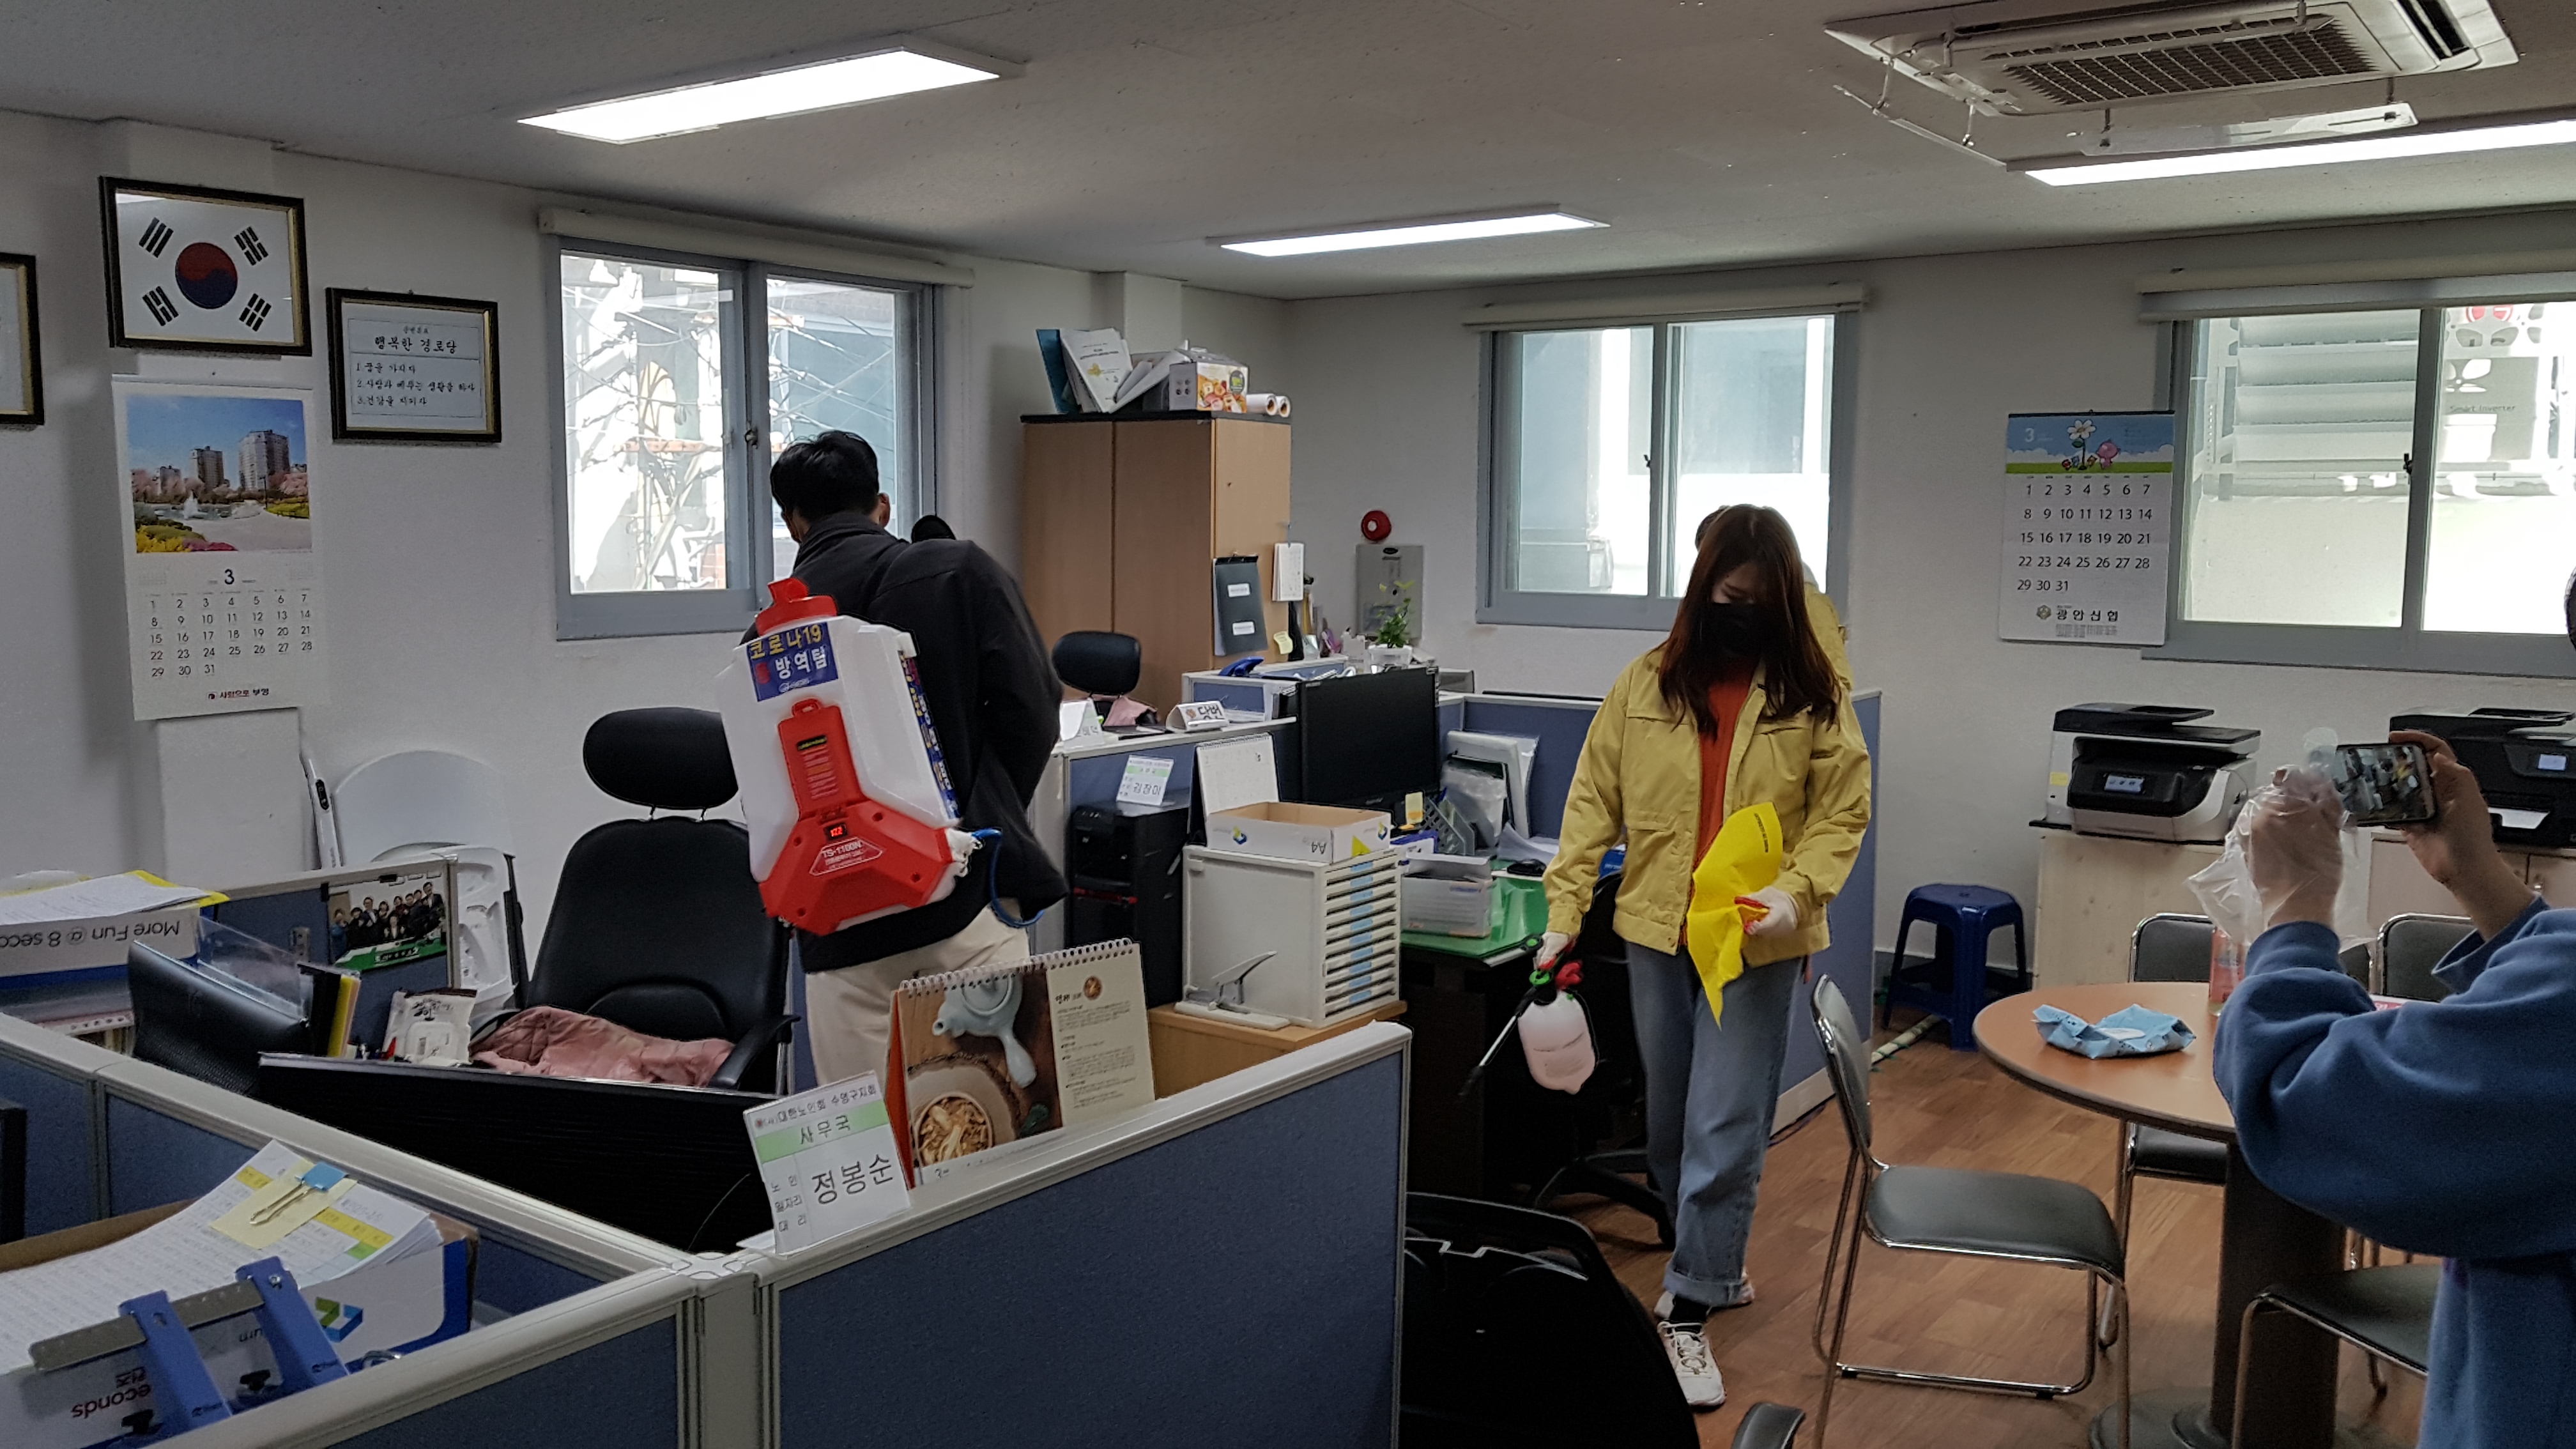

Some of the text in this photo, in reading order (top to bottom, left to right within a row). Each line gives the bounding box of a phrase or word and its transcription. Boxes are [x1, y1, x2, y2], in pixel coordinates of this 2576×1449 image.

[375, 336, 457, 353] 행복한 경로당
[2025, 427, 2034, 443] 3
[2027, 484, 2150, 496] 1 2 3 4 5 6 7
[2024, 508, 2152, 520] 8 9 10 11 12 13 14
[2021, 532, 2150, 544] 15 16 17 18 19 20 21
[2018, 556, 2150, 569] 22 23 24 25 26 27 28
[224, 569, 234, 585] 3
[2017, 579, 2068, 592] 29 30 31
[150, 594, 307, 609] 1 2 3 4 5 6 7
[151, 610, 310, 627] 8 9 10 11 12 13 14
[151, 625, 310, 643] 15 16 17 18 19 20 21
[751, 624, 822, 659] 코로나19
[150, 641, 312, 661] 22 23 24 25 26 27 28
[151, 664, 215, 677] 29 30 31
[1311, 841, 1327, 855] A4
[91, 925, 128, 942] Fun
[134, 921, 180, 937] More
[48, 931, 62, 947] 8
[831, 1084, 877, 1105] 수영구지회
[801, 1115, 851, 1144] 사무국
[811, 1154, 893, 1204] 정봉순
[72, 1384, 151, 1419] econds
